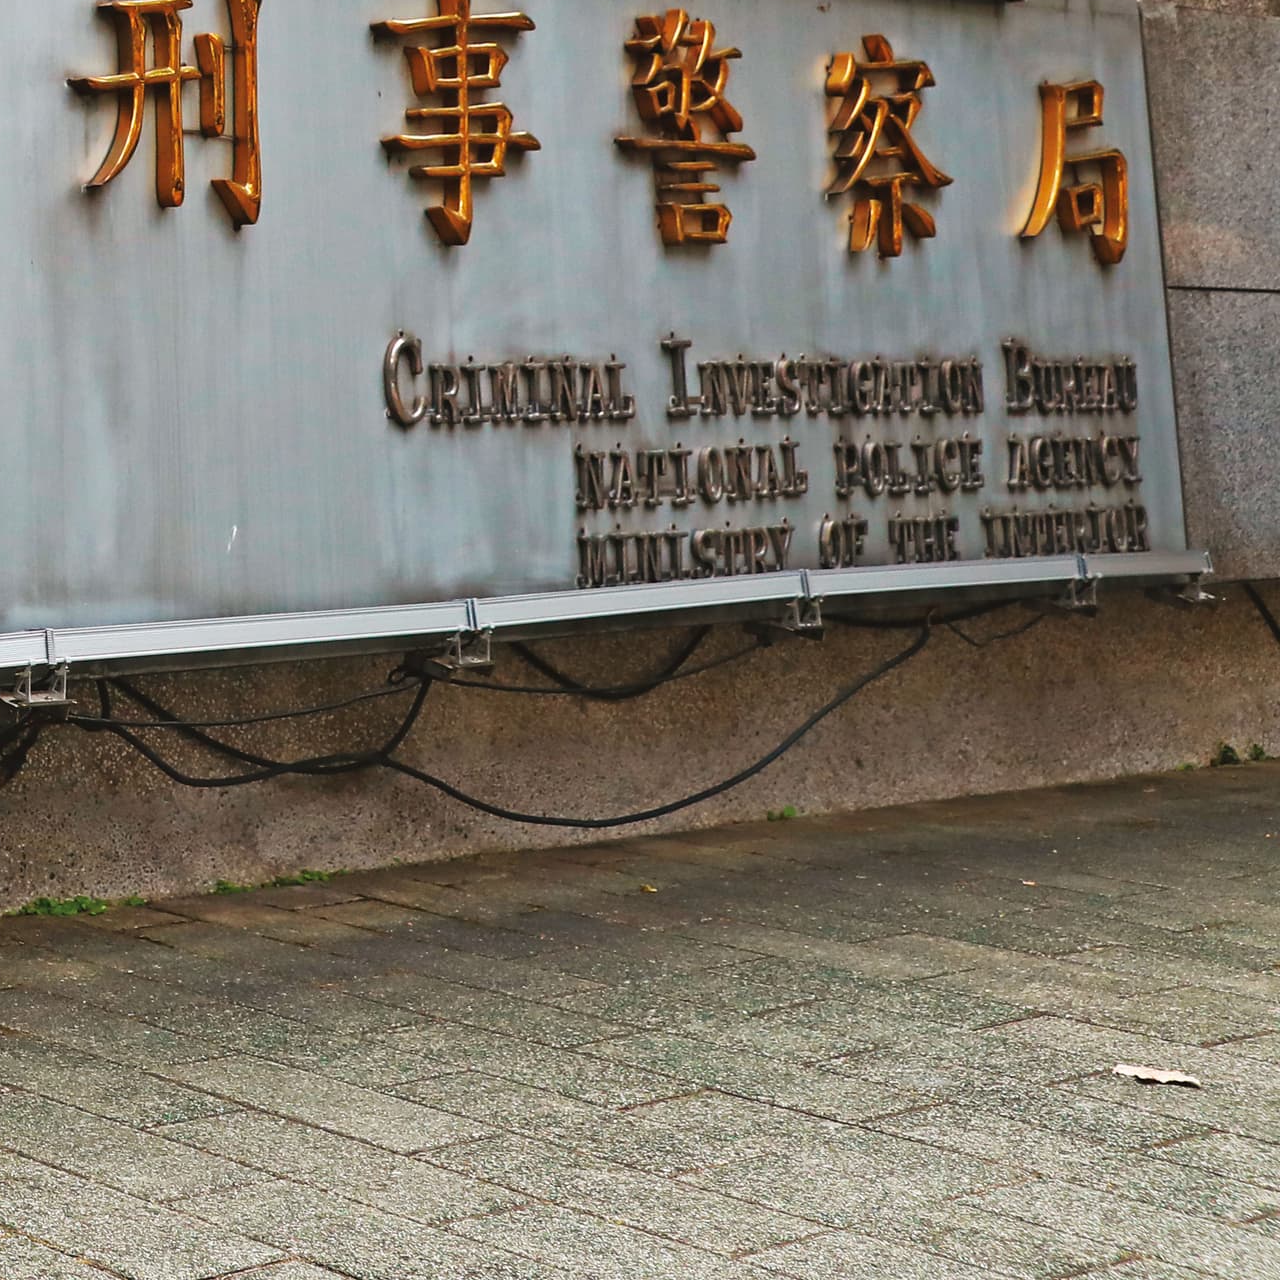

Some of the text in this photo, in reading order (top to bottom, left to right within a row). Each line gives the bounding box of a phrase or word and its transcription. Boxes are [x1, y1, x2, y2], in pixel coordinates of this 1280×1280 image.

[383, 332, 1139, 426] CRIMINAL INVESTIGATION BUREAU
[574, 436, 1143, 511] NATIONAL POLICE AGENCY
[576, 503, 1151, 588] MINISTRY OF THE INTERIOR
